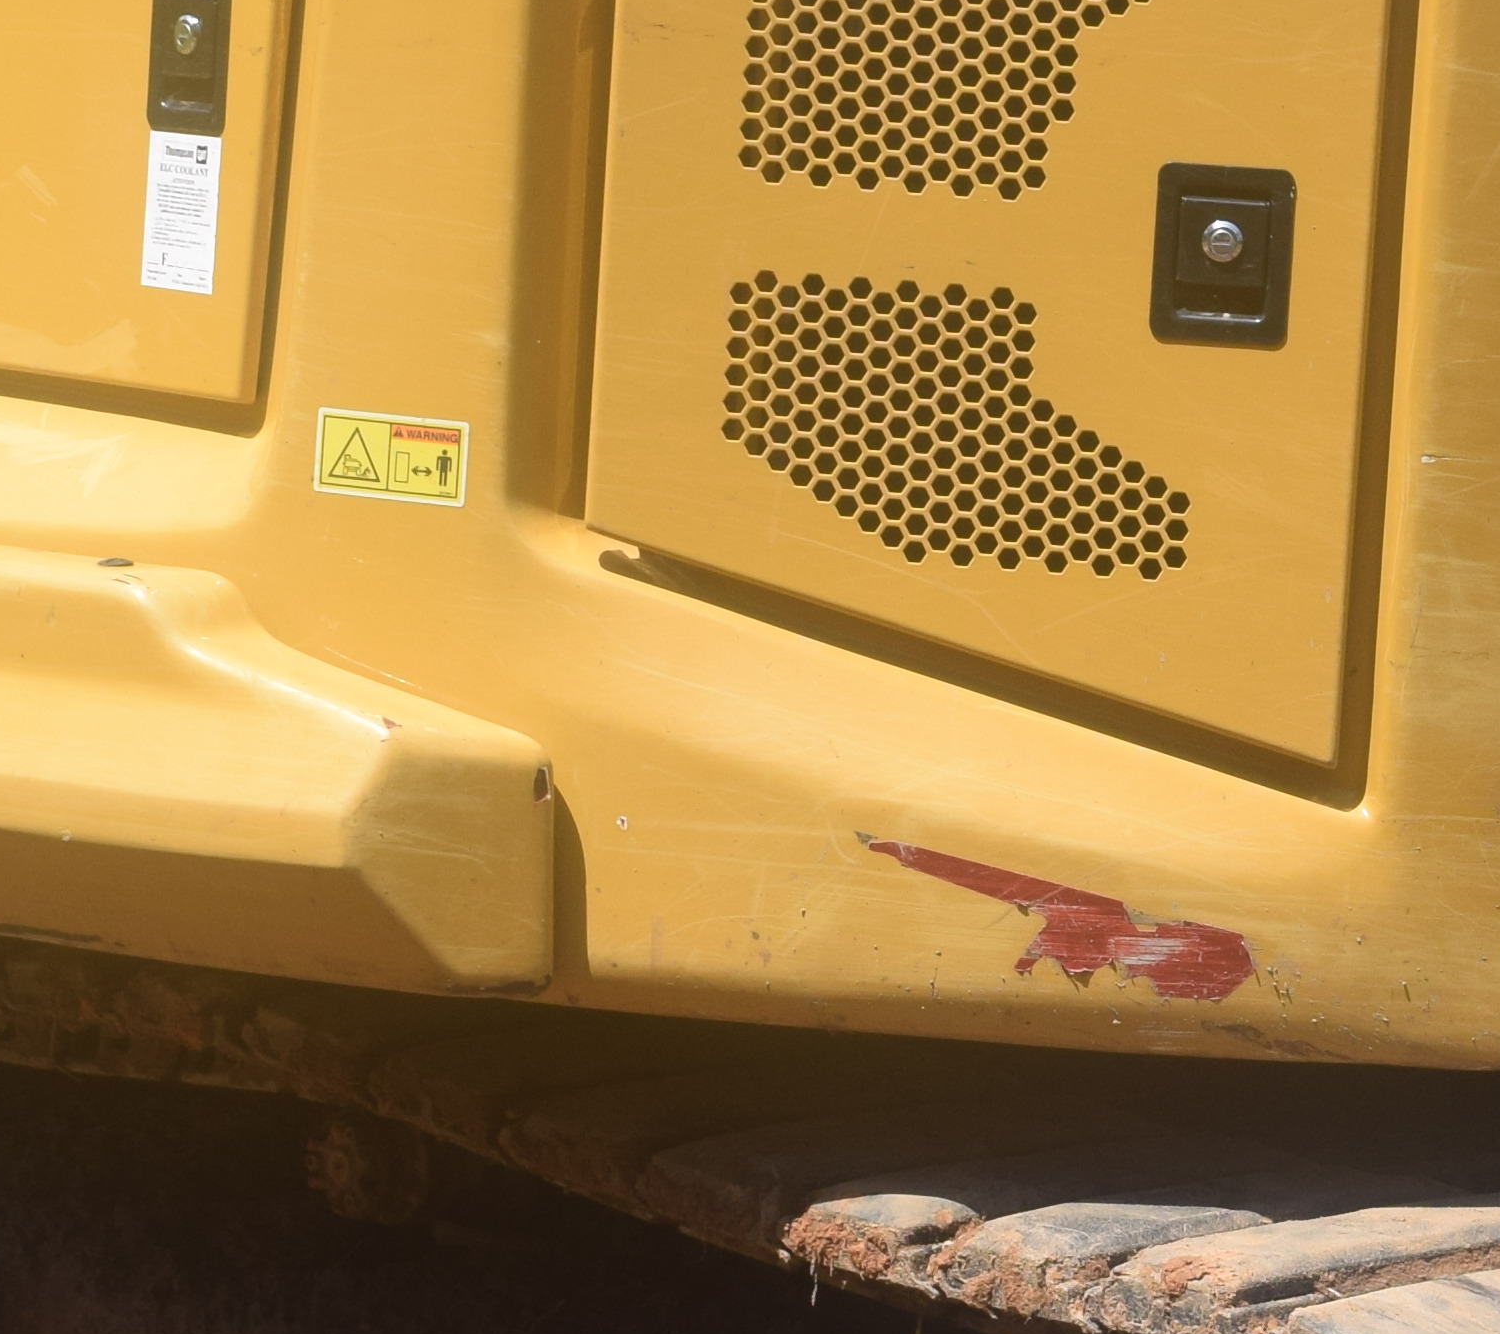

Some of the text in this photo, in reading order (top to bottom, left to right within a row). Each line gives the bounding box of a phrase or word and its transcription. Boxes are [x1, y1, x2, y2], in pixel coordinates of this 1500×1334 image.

[160, 162, 208, 177] ELC COOLANT
[406, 429, 458, 443] WARNING
